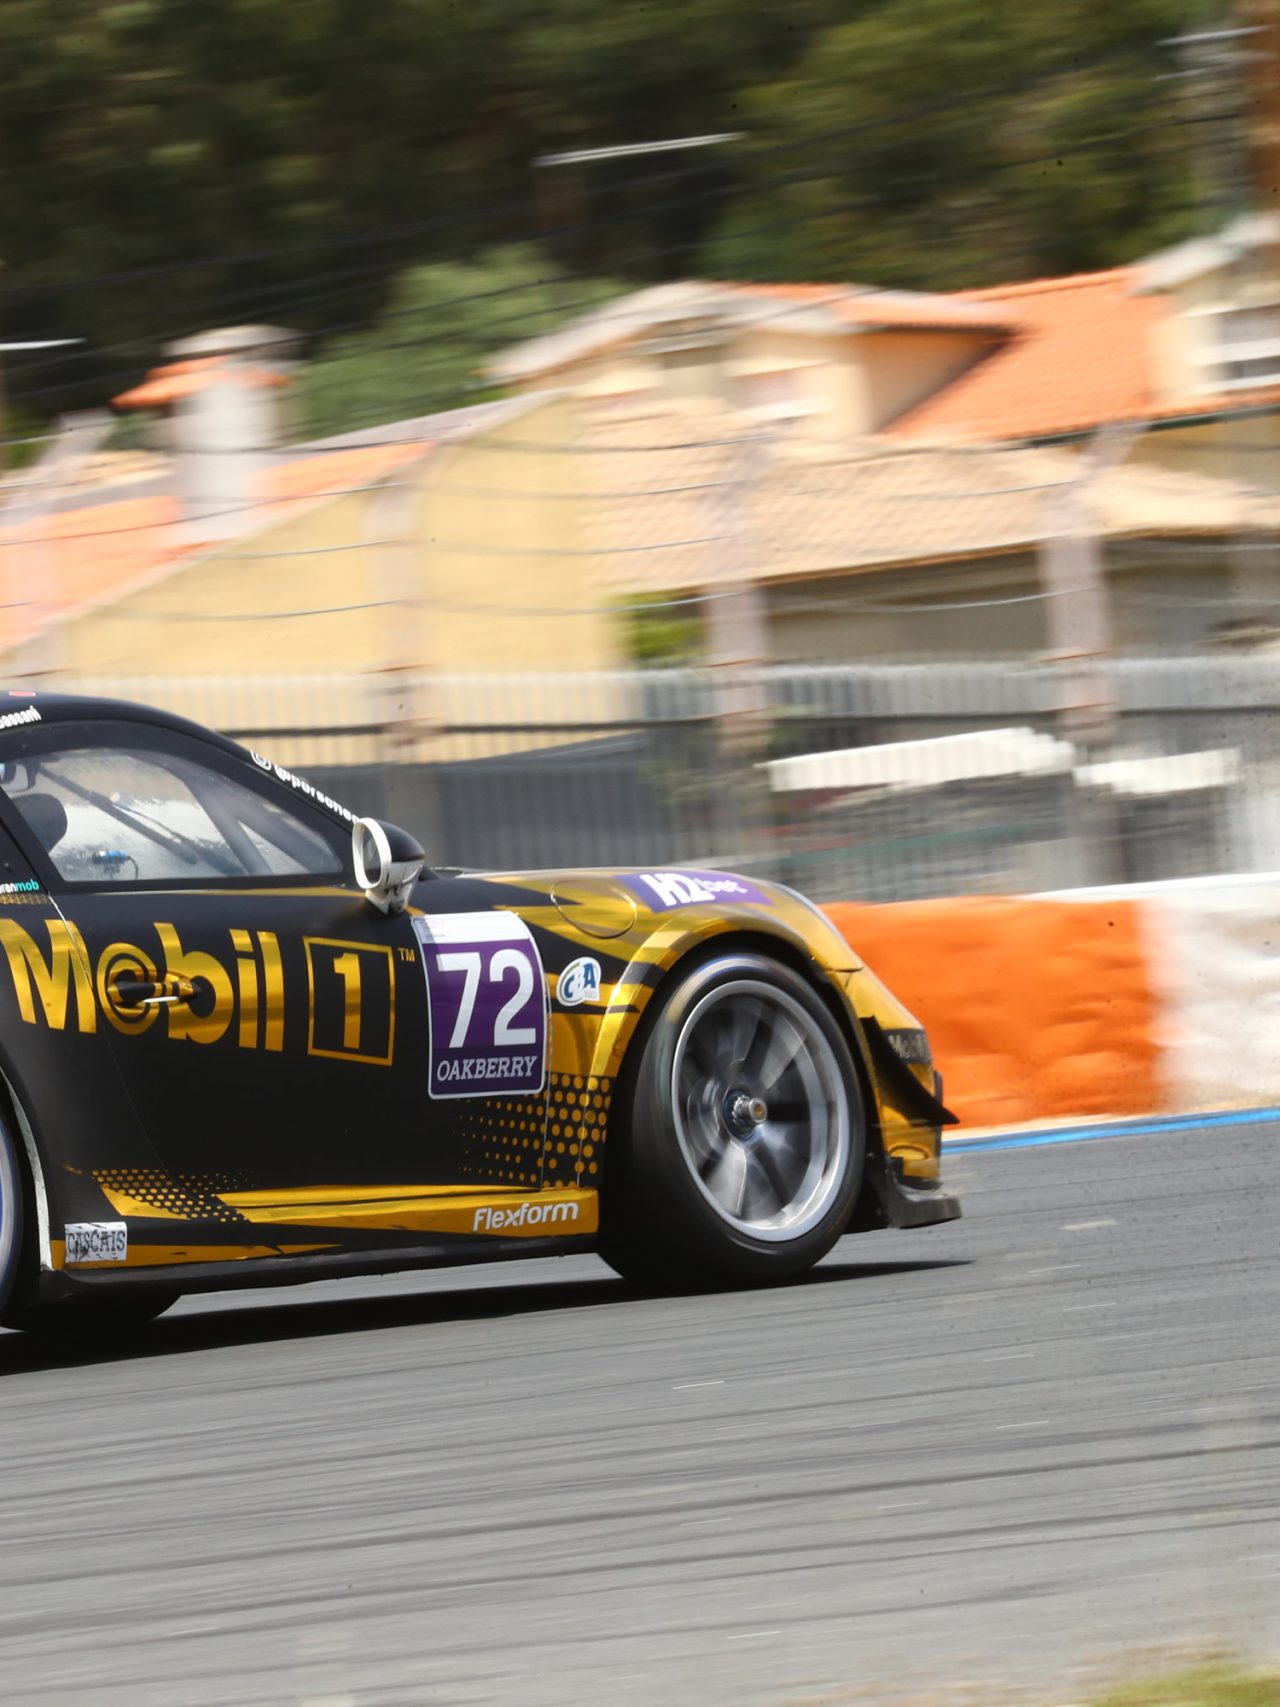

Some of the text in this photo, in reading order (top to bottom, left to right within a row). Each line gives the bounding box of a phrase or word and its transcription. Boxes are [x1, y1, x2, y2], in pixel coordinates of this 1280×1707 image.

[333, 952, 361, 1050] 1
[436, 948, 537, 1049] 72
[436, 1055, 538, 1082] OAKBERRY
[472, 1201, 579, 1232] Flexform
